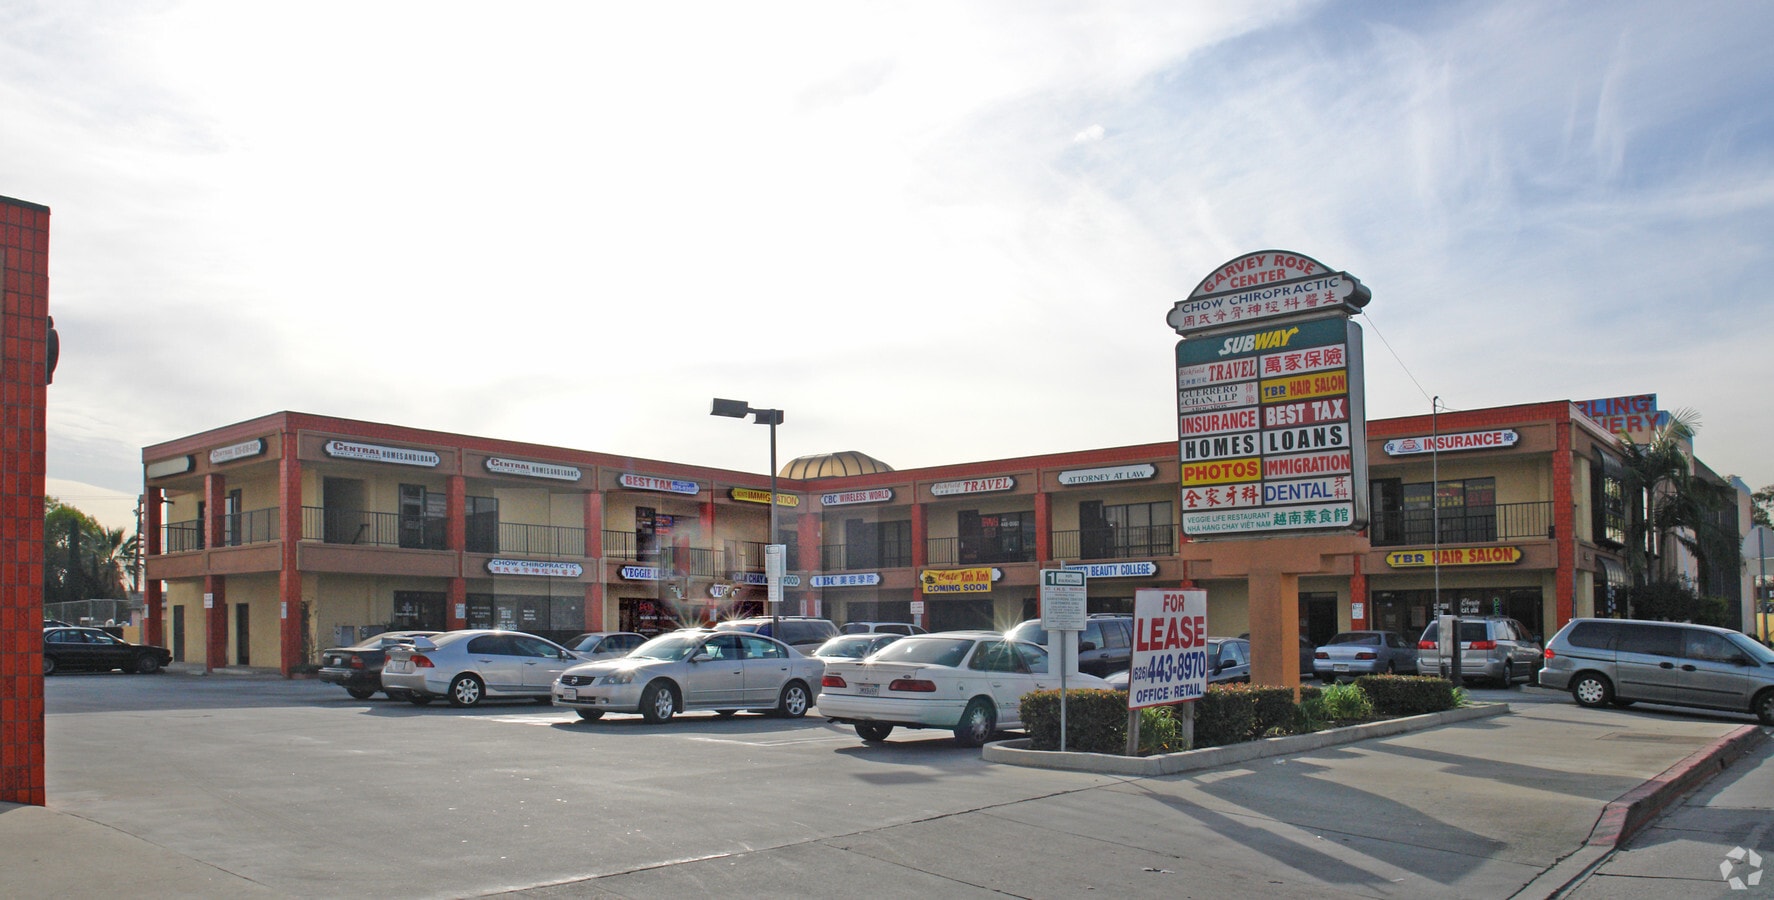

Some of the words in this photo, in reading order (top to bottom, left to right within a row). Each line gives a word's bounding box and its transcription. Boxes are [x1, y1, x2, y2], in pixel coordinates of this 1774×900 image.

[1204, 255, 1266, 293] GARVEY
[1273, 254, 1316, 275] ROSE
[1229, 268, 1287, 289] CENTER
[1182, 298, 1224, 314] CHOW
[1229, 277, 1339, 305] CHIROPRACTIC
[1218, 326, 1299, 357] SUBWAY
[1264, 347, 1343, 374] 萬家保險
[1208, 360, 1257, 382] TRAVEL
[1181, 385, 1238, 398] GUERRERO
[1264, 385, 1287, 397] TBR
[1289, 380, 1311, 397] HAIR
[1315, 374, 1345, 394] SALON
[1218, 393, 1237, 402] LLP
[1181, 410, 1256, 434] INSURANCE
[1266, 404, 1306, 426] BEST
[1312, 399, 1345, 420] TAX
[1185, 434, 1255, 459] HOMES
[1269, 425, 1343, 451] LOANS
[1423, 432, 1502, 450] INSURANCE
[1184, 461, 1258, 481] PHOTOS
[1264, 453, 1350, 476] IMMIGRATION
[625, 475, 652, 487] BEST
[653, 479, 673, 490] TAX
[963, 477, 1010, 492] TRAVEL
[1067, 473, 1110, 483] ATTORNEY
[1113, 472, 1124, 480] AT
[1126, 470, 1146, 479] LAW
[748, 491, 797, 505] IMMIGATION
[823, 495, 838, 504] CBC
[839, 492, 867, 503] WIRELESS
[868, 489, 889, 500] WORLD
[1184, 485, 1259, 508] 全家牙科
[1265, 481, 1333, 501] DENTAL
[1187, 515, 1210, 524] VEGGIE
[1212, 514, 1226, 523] LIFE
[1227, 512, 1270, 521] RESTAURANT
[1256, 520, 1271, 528] NAM
[1273, 507, 1349, 526] 越南素食館
[520, 561, 576, 569] CHIROPRACTIC
[1393, 553, 1425, 563] TBR
[1432, 549, 1463, 564] HAIR
[1468, 547, 1514, 563] SALON
[624, 567, 652, 578] VEGGIE
[1091, 564, 1117, 576] BEAUTY
[1121, 563, 1150, 575] COLLEGE
[927, 584, 960, 592] COMING
[963, 583, 988, 591] SOON
[1163, 594, 1185, 613] FOR
[1136, 616, 1205, 652] LEASE
[1136, 687, 1169, 703] OFFICE
[1174, 683, 1202, 698] RETAIL
